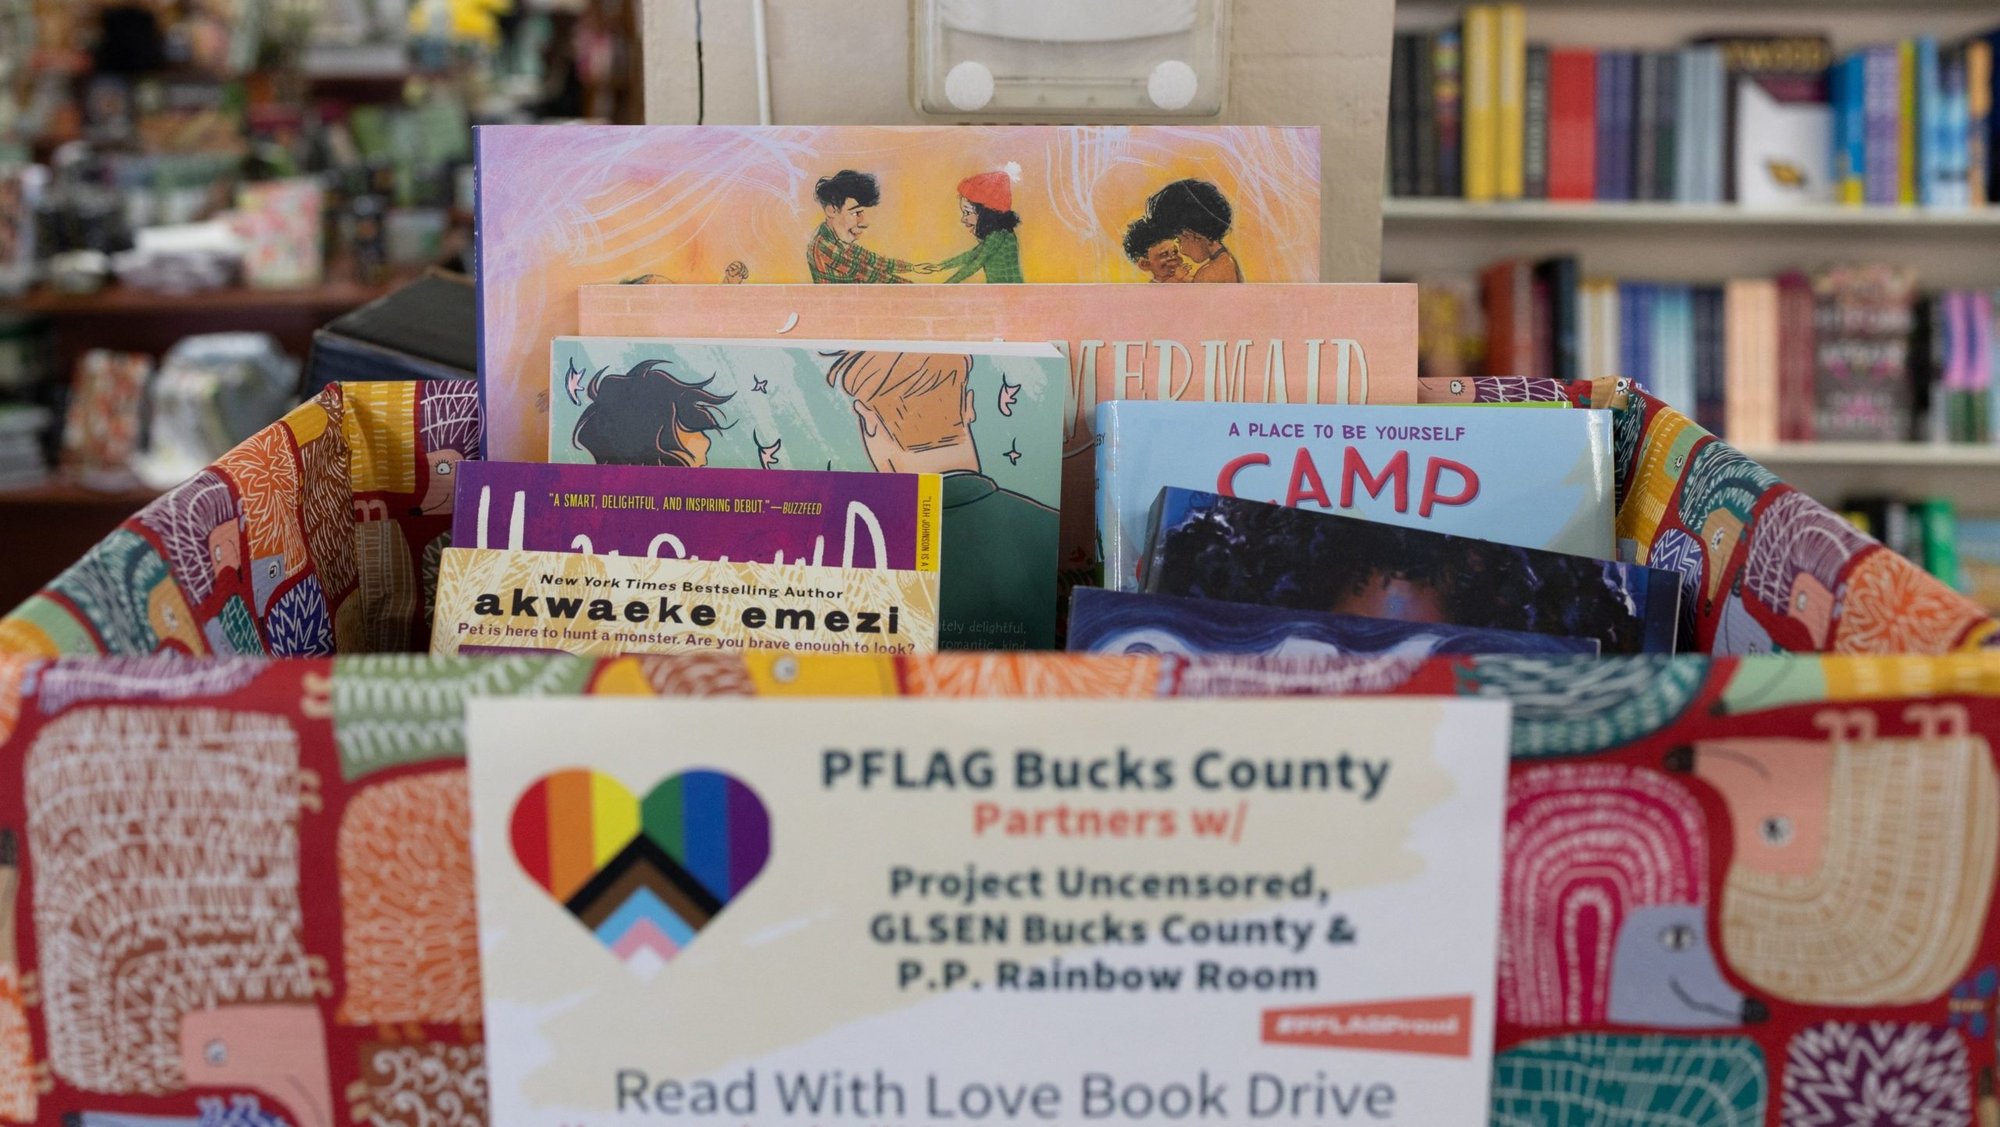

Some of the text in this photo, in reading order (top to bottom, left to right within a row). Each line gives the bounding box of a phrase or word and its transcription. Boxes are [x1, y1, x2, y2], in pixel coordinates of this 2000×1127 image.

[1228, 422, 1466, 442] A PLACE TO BE YOURSELF
[1216, 445, 1481, 518] CAMP
[564, 493, 599, 510] SMART,
[602, 495, 660, 512] DELIGHTFUL,
[663, 496, 683, 512] AND
[685, 496, 731, 513] INSPIRING
[920, 519, 931, 552] JOHNSON
[540, 574, 844, 600] New York Times Bestselling Author
[474, 588, 899, 634] akwaeke emezi
[457, 622, 916, 656] Pet is here to hunt a monster. Are you brave enough to look?
[822, 746, 1390, 802] PFLAG Bucks County
[973, 801, 1249, 845] Partners w/
[889, 864, 1331, 904] Project Uncensored,
[869, 912, 1357, 952] GLSEN Bucks County &
[897, 957, 1319, 992] P.P. Rainbow Room
[613, 1067, 1399, 1120] Read With Love Book Drive
